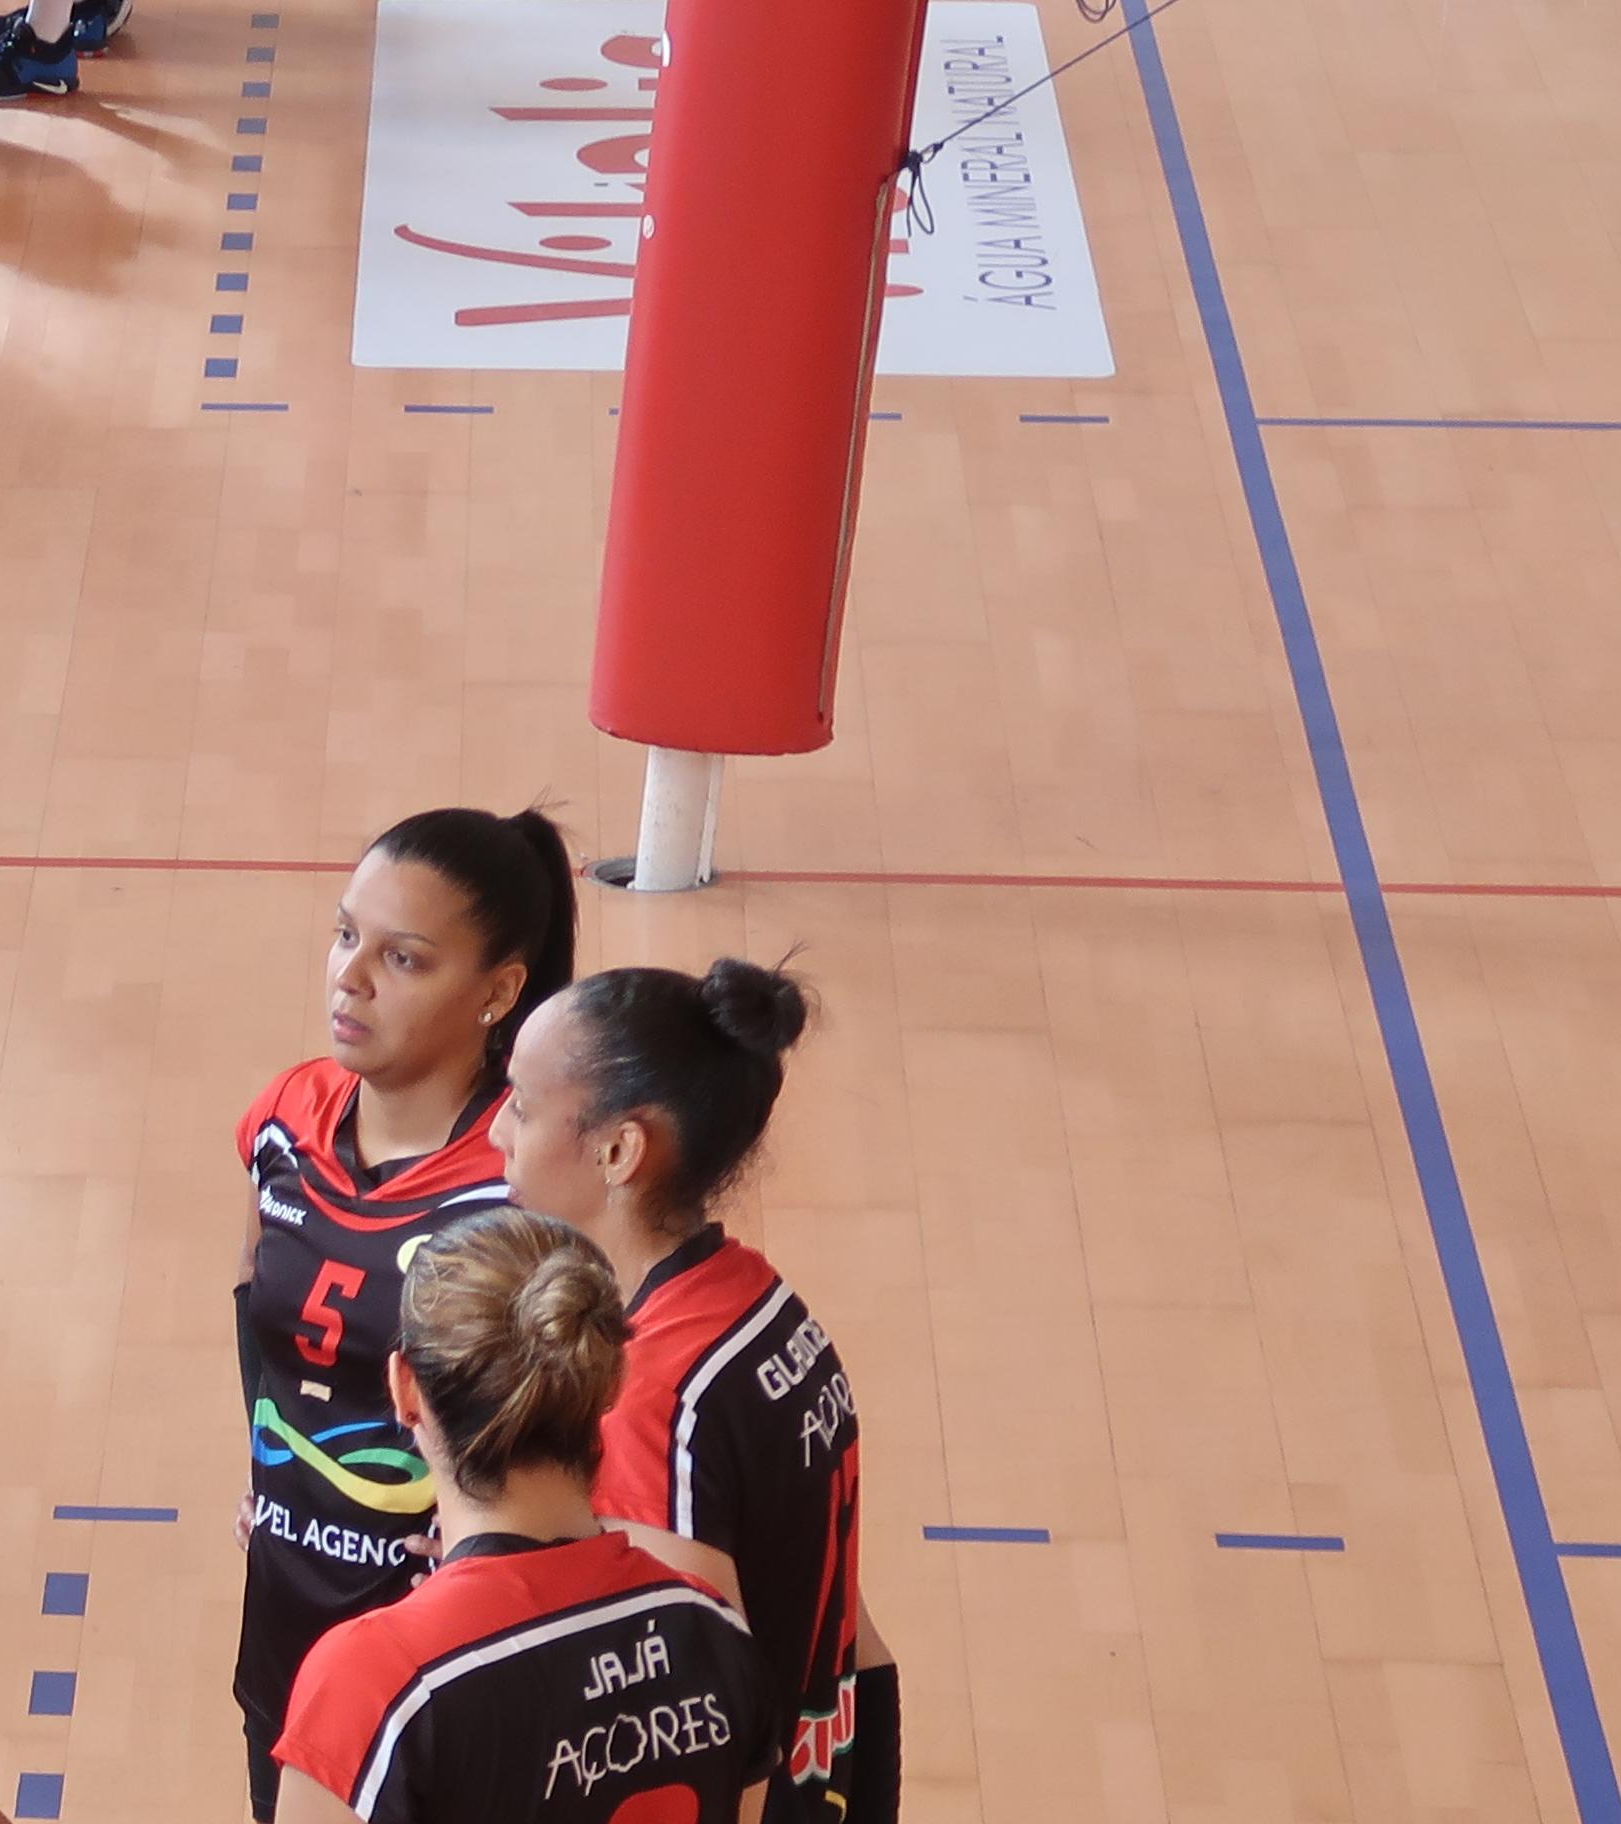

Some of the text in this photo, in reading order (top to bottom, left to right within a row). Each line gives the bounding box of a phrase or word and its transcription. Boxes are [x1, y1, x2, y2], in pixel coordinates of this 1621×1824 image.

[939, 35, 1057, 310] ÁGUA MINERAL NATURAL
[294, 1258, 367, 1367] 5
[584, 1619, 671, 1700] JAJÁ
[545, 1693, 732, 1800] AÇORES
